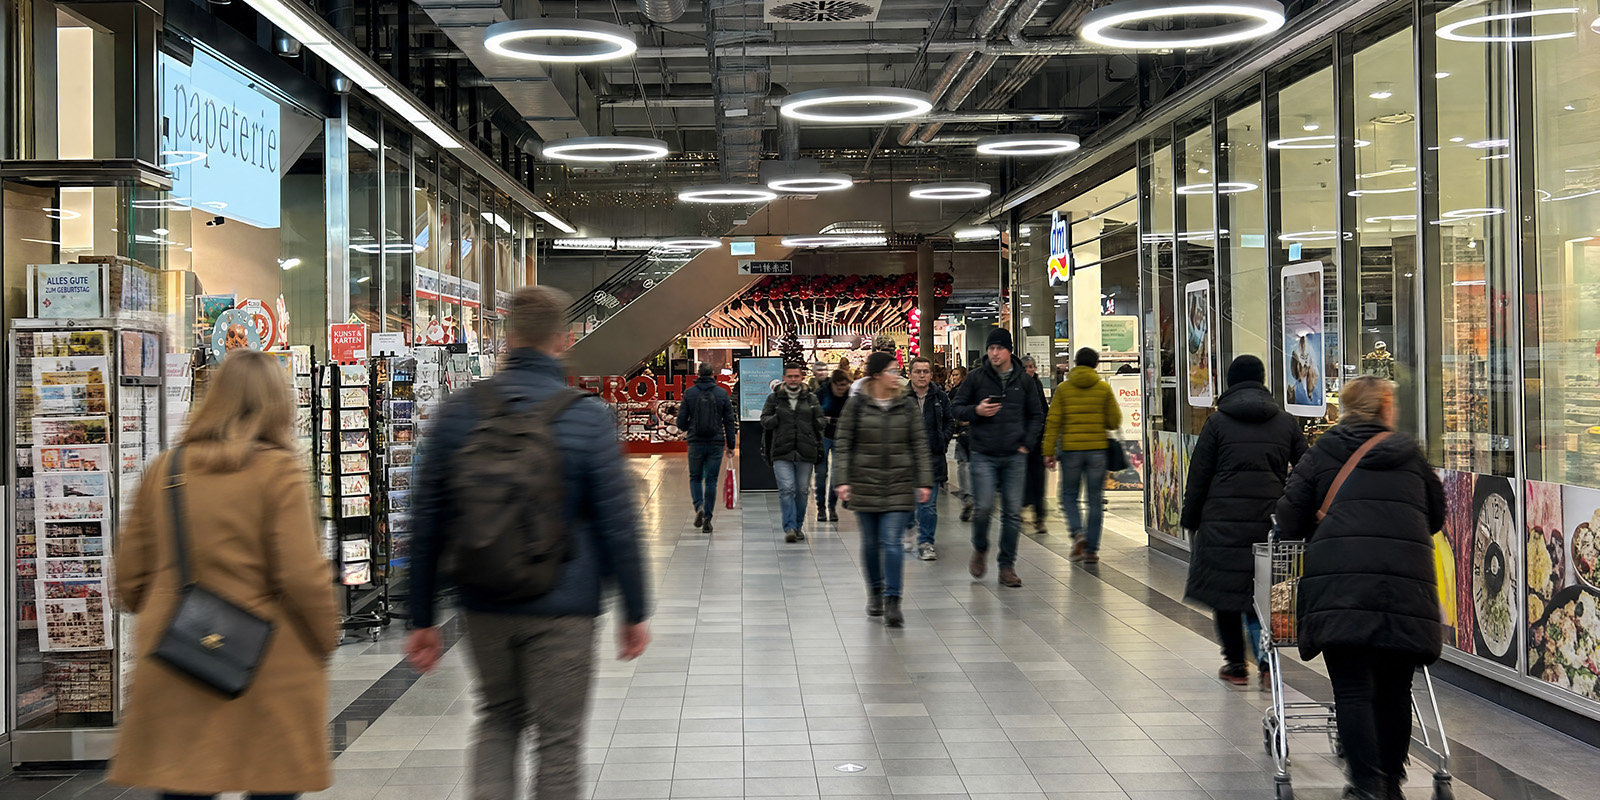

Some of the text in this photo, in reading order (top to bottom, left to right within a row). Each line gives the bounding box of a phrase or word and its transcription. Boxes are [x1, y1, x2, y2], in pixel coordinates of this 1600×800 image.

[171, 83, 277, 173] papeterie
[1051, 217, 1065, 256] dm
[47, 276, 89, 285] ALLES GUTE
[57, 286, 90, 294] GEBURTSTAG
[333, 330, 356, 338] KUNST
